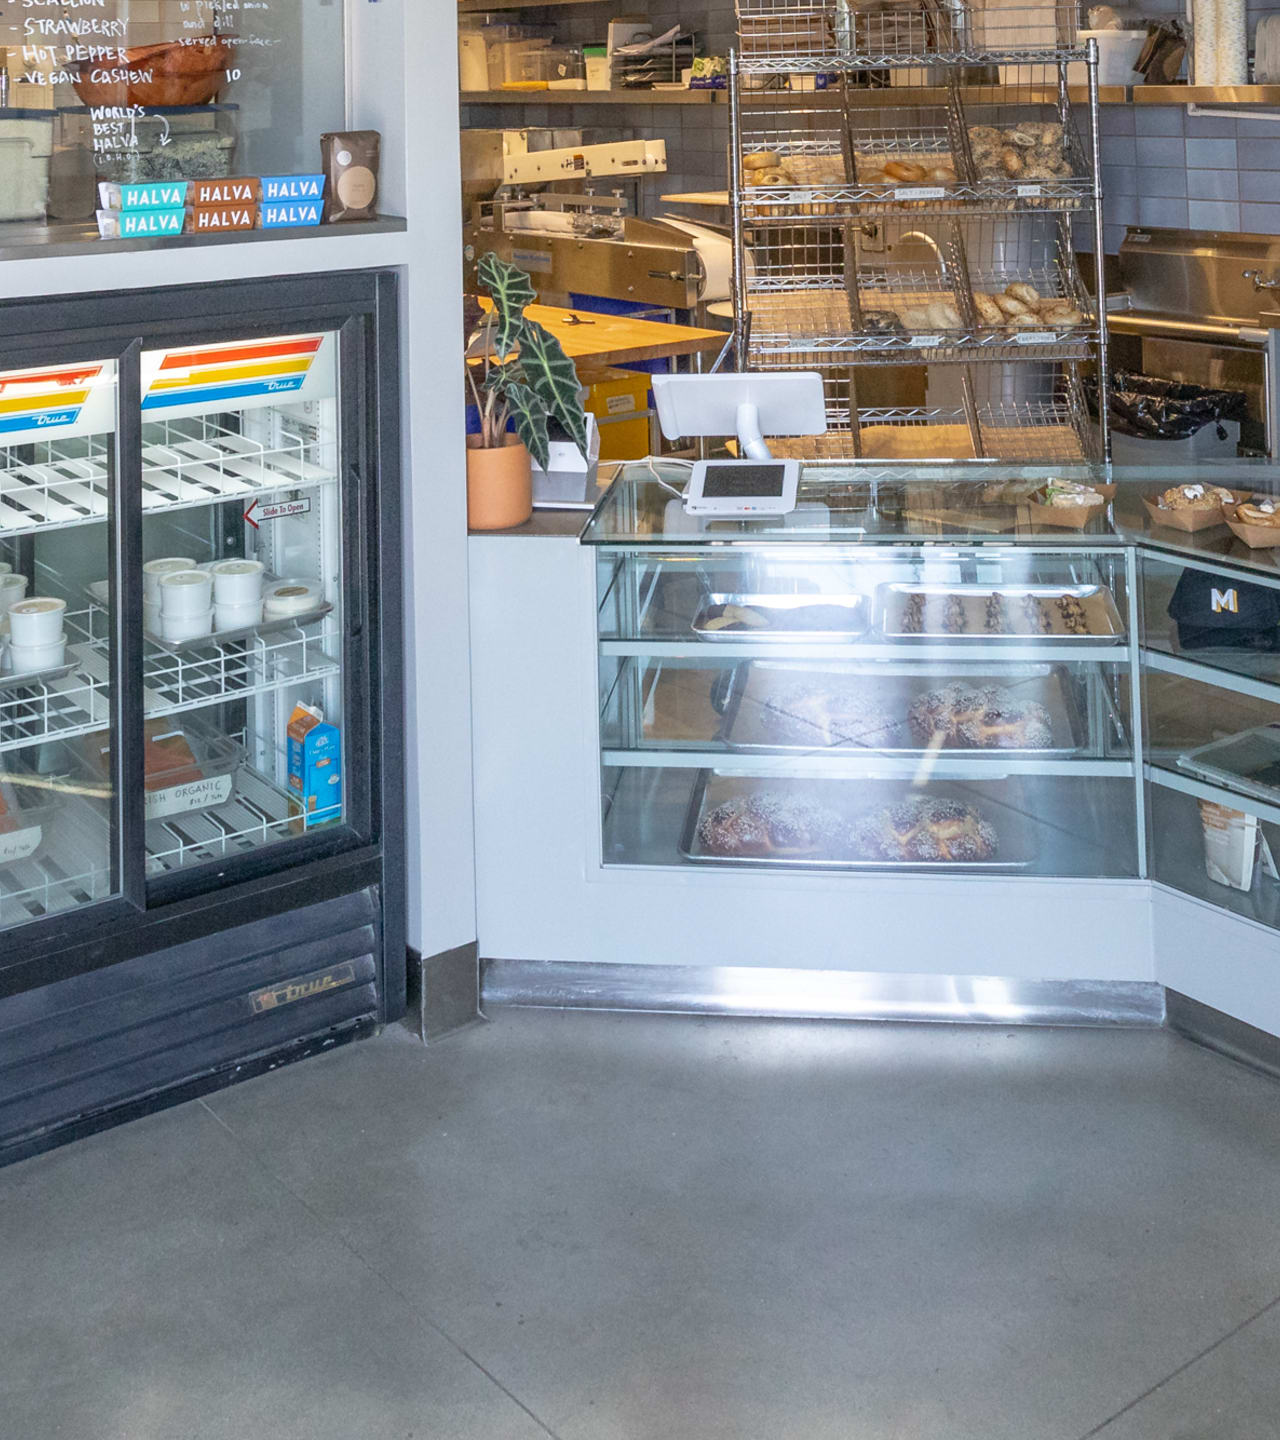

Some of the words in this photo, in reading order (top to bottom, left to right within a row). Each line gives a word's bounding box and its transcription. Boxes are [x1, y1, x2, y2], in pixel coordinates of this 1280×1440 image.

[23, 17, 129, 37] STRAWBERRY
[214, 14, 234, 30] dill
[22, 45, 57, 65] HOT
[65, 45, 130, 64] PEPPER
[25, 70, 82, 86] VEGAN
[225, 68, 241, 83] 10
[90, 104, 146, 121] WORLD'S
[93, 122, 125, 135] BEST
[93, 135, 138, 152] HALVA
[126, 189, 181, 207] HALVA
[200, 184, 252, 202] HALVA
[268, 180, 319, 198] HALVA
[125, 215, 180, 233] HALVA
[198, 210, 250, 228] HALVA
[267, 206, 317, 224] HALVA
[263, 506, 278, 517] Slide
[279, 505, 286, 514] To
[287, 502, 304, 515] Open
[1211, 588, 1238, 613] M
[175, 779, 222, 799] ORGANIC
